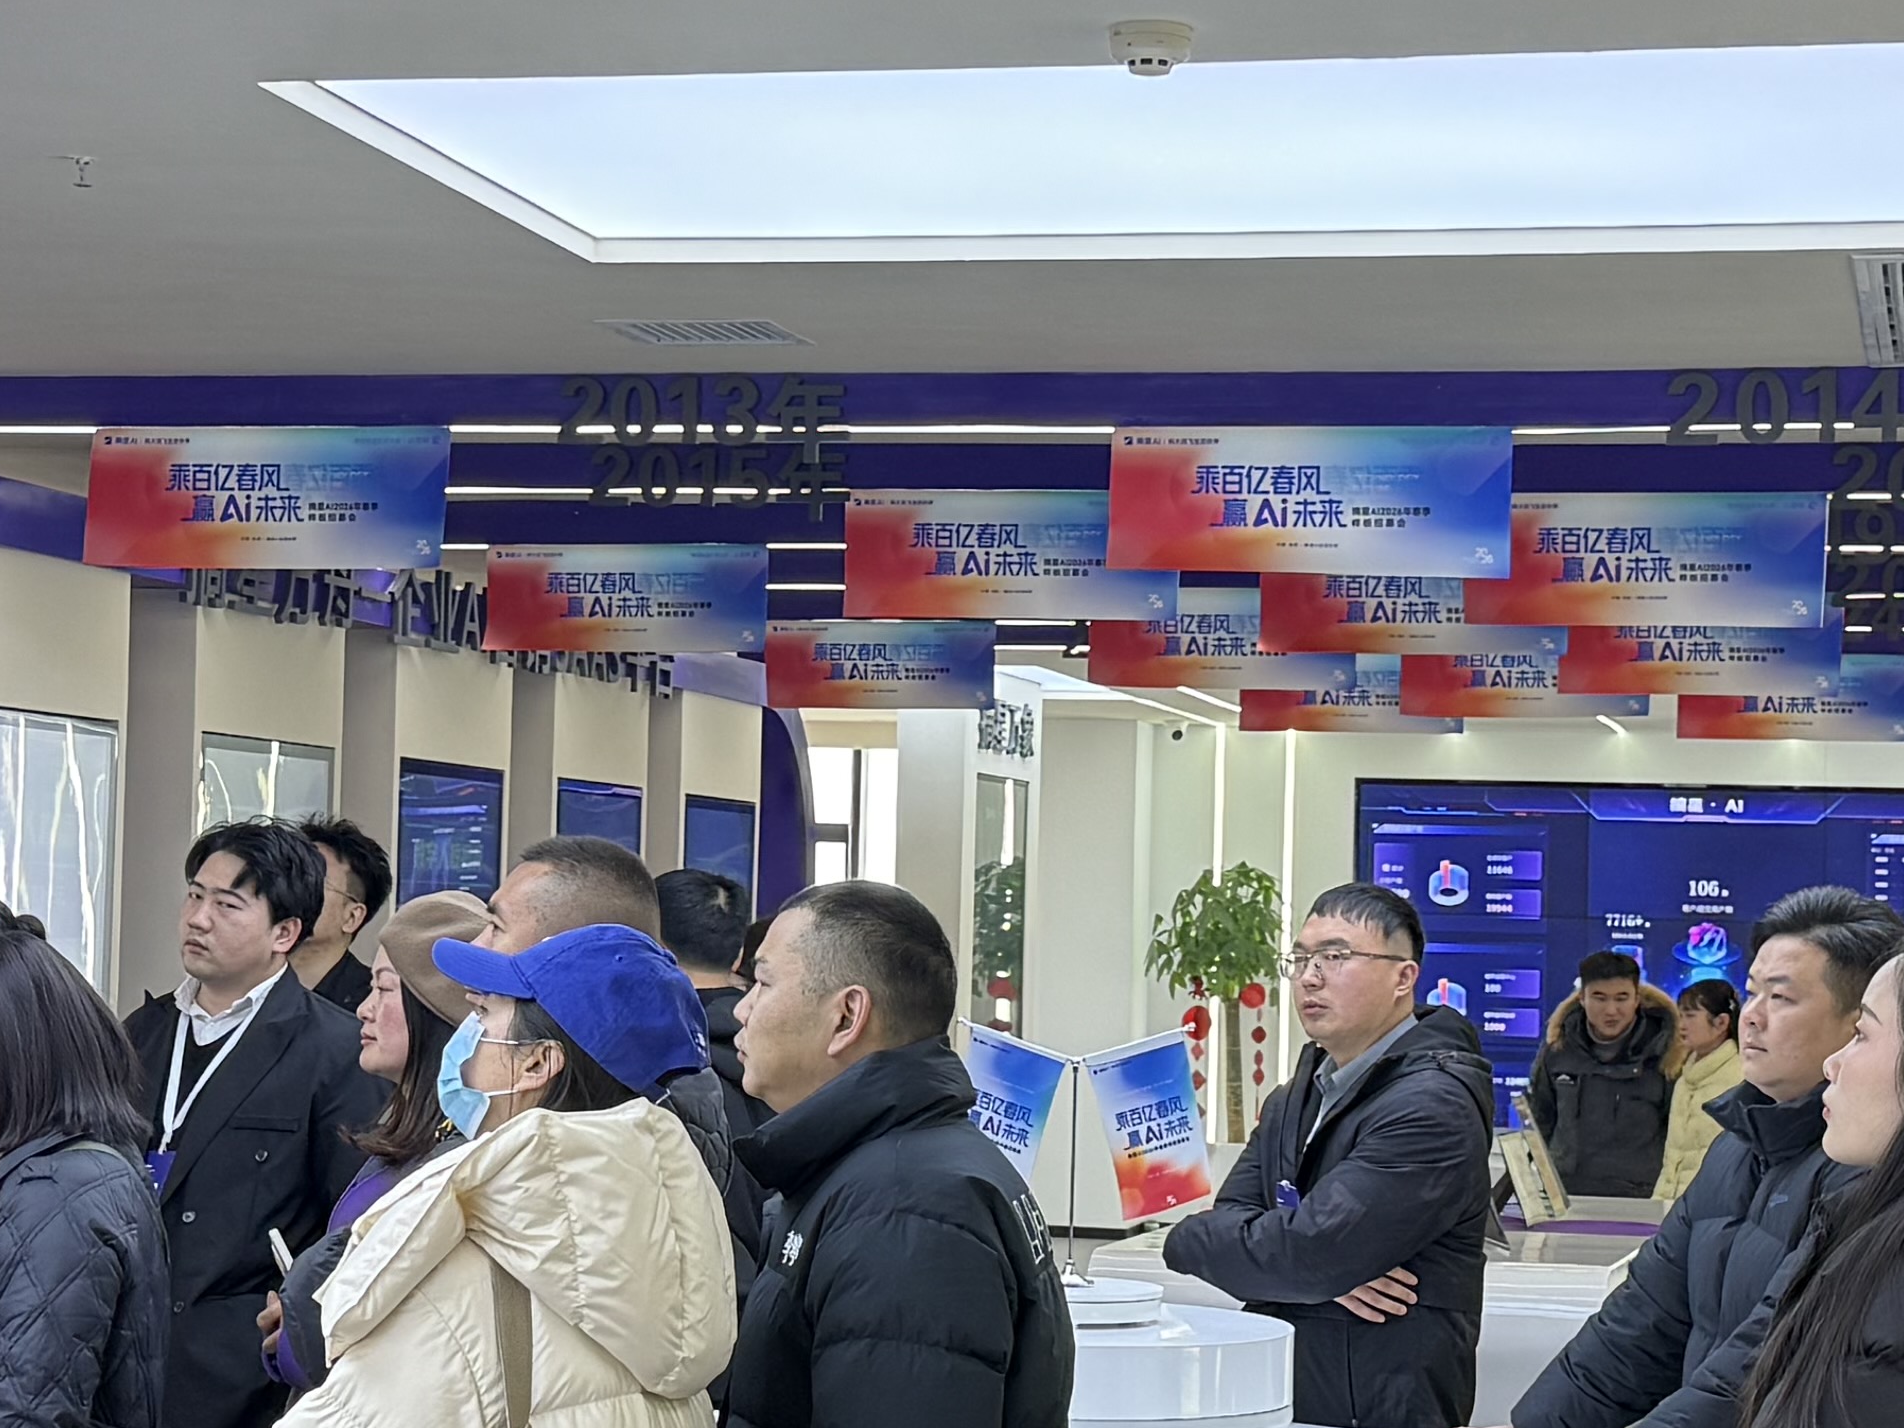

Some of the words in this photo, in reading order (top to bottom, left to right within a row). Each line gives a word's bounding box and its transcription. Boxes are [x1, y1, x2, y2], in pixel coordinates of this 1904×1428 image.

[554, 372, 850, 464] 2013年
[165, 463, 290, 492] 乘百亿春风
[588, 446, 851, 522] 2015年
[1190, 464, 1331, 495] 乘百亿春风
[180, 494, 305, 523] 赢Ai未来
[1208, 497, 1348, 528] 赢Ai未来
[908, 523, 1027, 549] 乘百亿春风
[1533, 527, 1661, 554] 乘百亿春风
[925, 551, 1040, 577] 赢Ai未来
[1551, 556, 1676, 583] 赢Ai未来
[544, 572, 643, 594] 乘百亿春风
[1322, 576, 1430, 598] 乘百亿春风
[560, 596, 655, 618] 赢Ai未来
[1337, 600, 1443, 624] 赢Ai未来
[812, 642, 893, 662] 乘百亿春风
[975, 1090, 1034, 1128] 百亿春风
